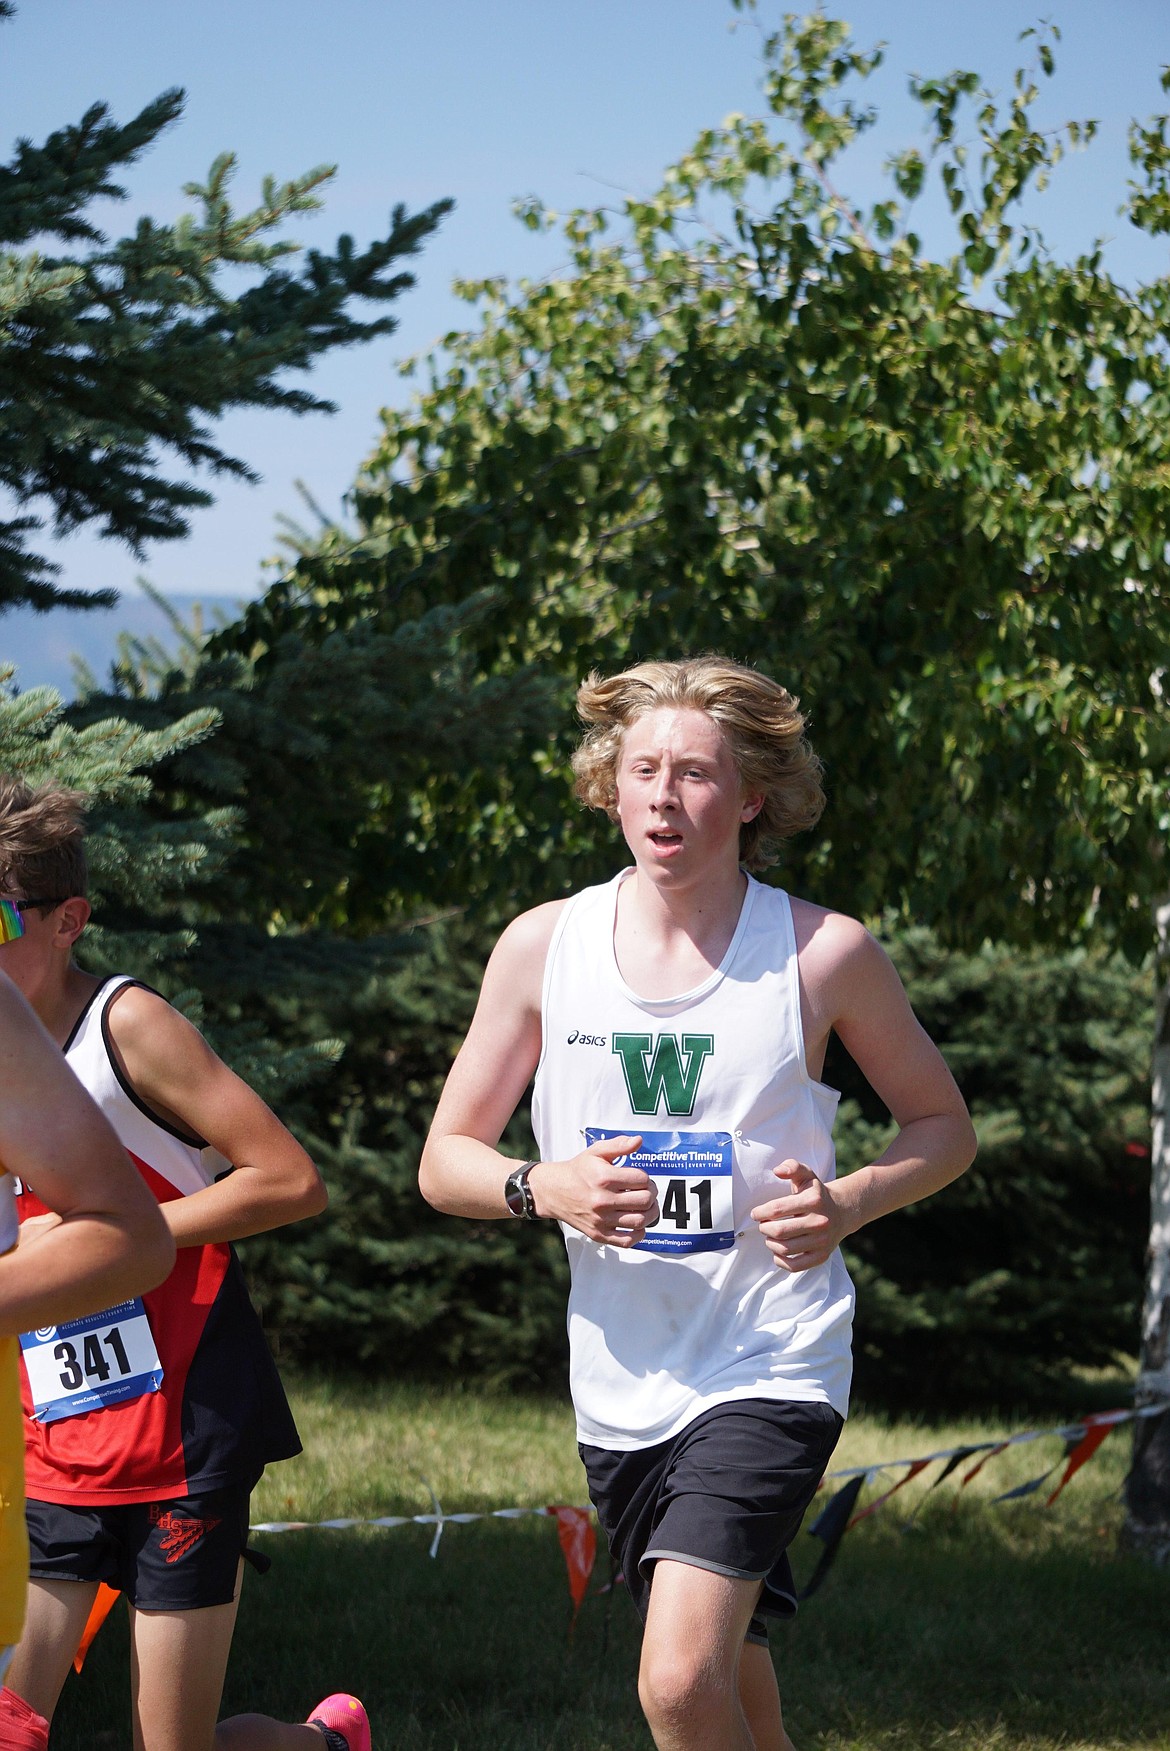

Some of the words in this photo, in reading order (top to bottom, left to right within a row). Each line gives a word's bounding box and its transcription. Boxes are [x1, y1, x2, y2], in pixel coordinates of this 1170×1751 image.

[612, 1032, 714, 1117] W
[645, 1179, 713, 1229] 41
[53, 1327, 132, 1390] 341
